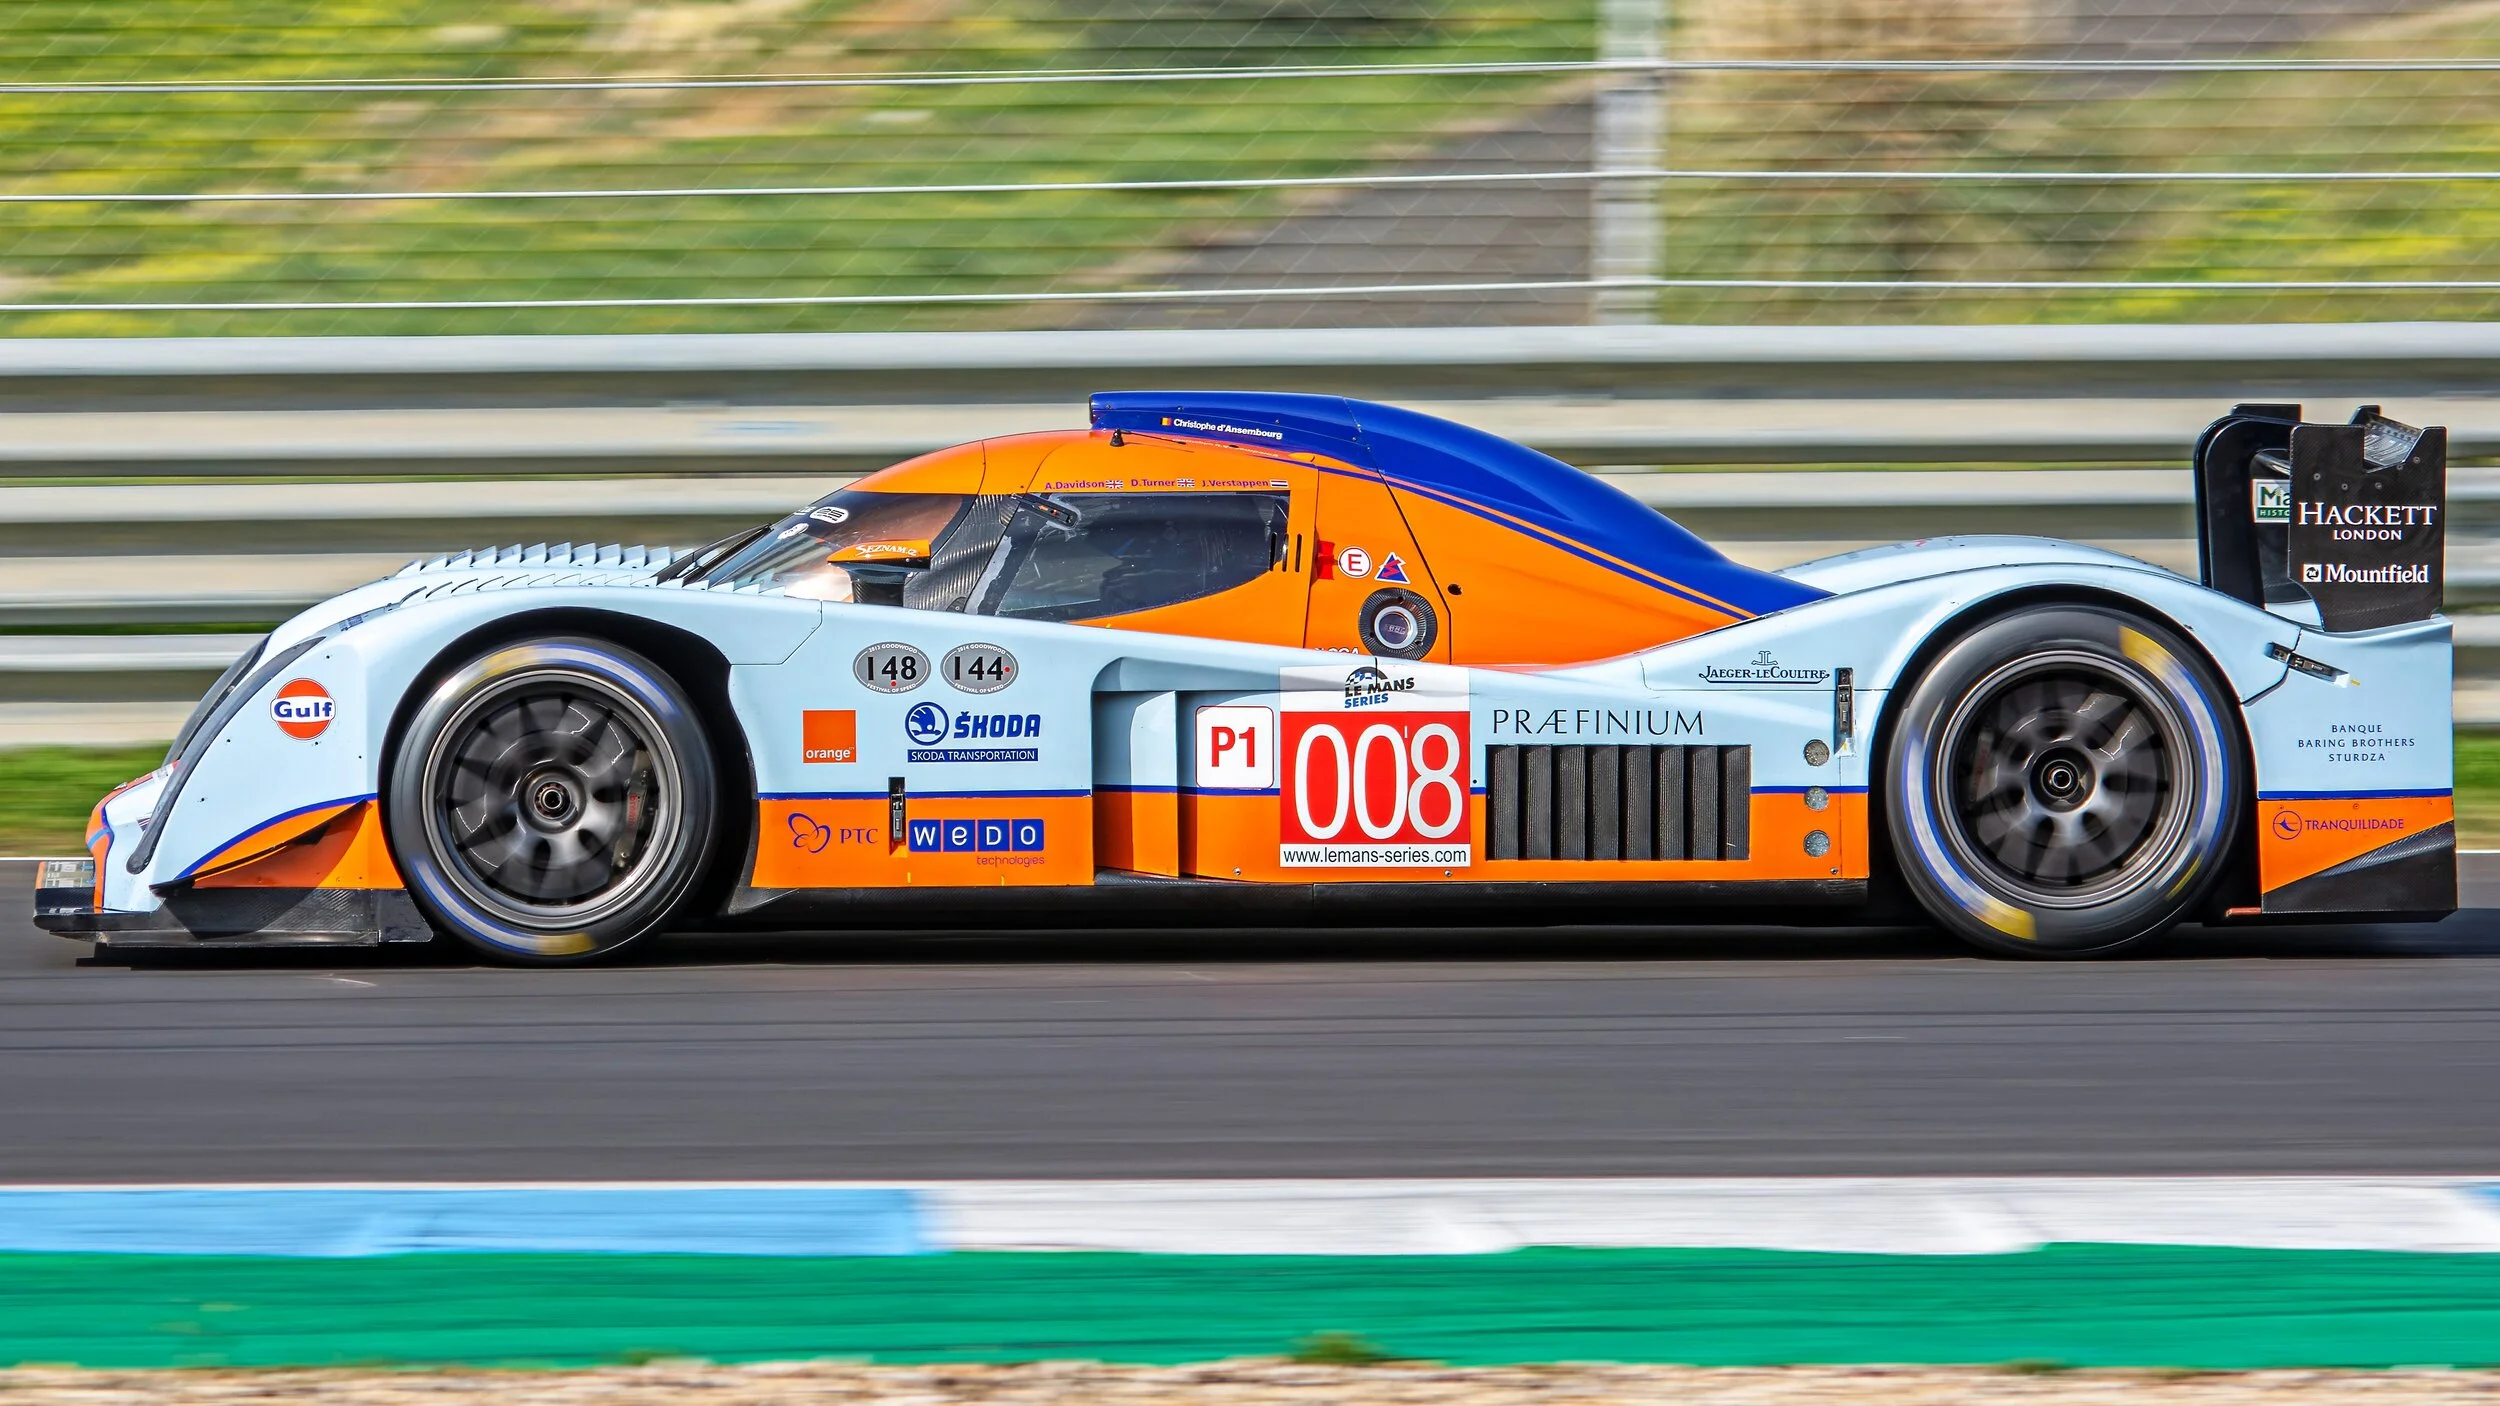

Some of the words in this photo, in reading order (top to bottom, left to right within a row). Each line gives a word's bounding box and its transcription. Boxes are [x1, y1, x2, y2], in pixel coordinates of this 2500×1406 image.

[1173, 418, 1216, 431] Christophe
[1216, 424, 1283, 440] d'Ansembourg
[2298, 502, 2438, 526] HACKETT
[2333, 529, 2402, 541] LONDON
[1347, 553, 1363, 572] E
[2325, 563, 2430, 583] Mountfield
[881, 643, 918, 654] GOODWOOD
[969, 643, 1006, 655] GOODWOOD
[867, 655, 917, 681] 148
[954, 656, 1004, 681] 144
[866, 683, 890, 693] FESTIVAL
[900, 683, 917, 692] SPEED
[954, 683, 979, 693] FESTIVAL
[987, 684, 1004, 693] SPEED
[1345, 685, 1362, 697] LE
[1367, 677, 1415, 694] MANS
[1344, 693, 1389, 708] SERIES
[274, 700, 332, 718] Gulf
[953, 711, 1041, 738] ŠKODA
[2331, 724, 2383, 734] BANQUE
[1211, 726, 1255, 767] P1
[2298, 739, 2346, 748] BARING
[2352, 738, 2416, 748] BROTHERS
[806, 749, 851, 761] orange
[947, 750, 1035, 760] TRANSPORTATION
[2328, 753, 2386, 762] STURDZA
[1294, 723, 1463, 840] 008
[2305, 818, 2405, 831] TRANQUILIDADE
[840, 828, 878, 844] PTC
[976, 855, 1045, 867] technologies
[1283, 847, 1467, 863] www.lemans-series.com
